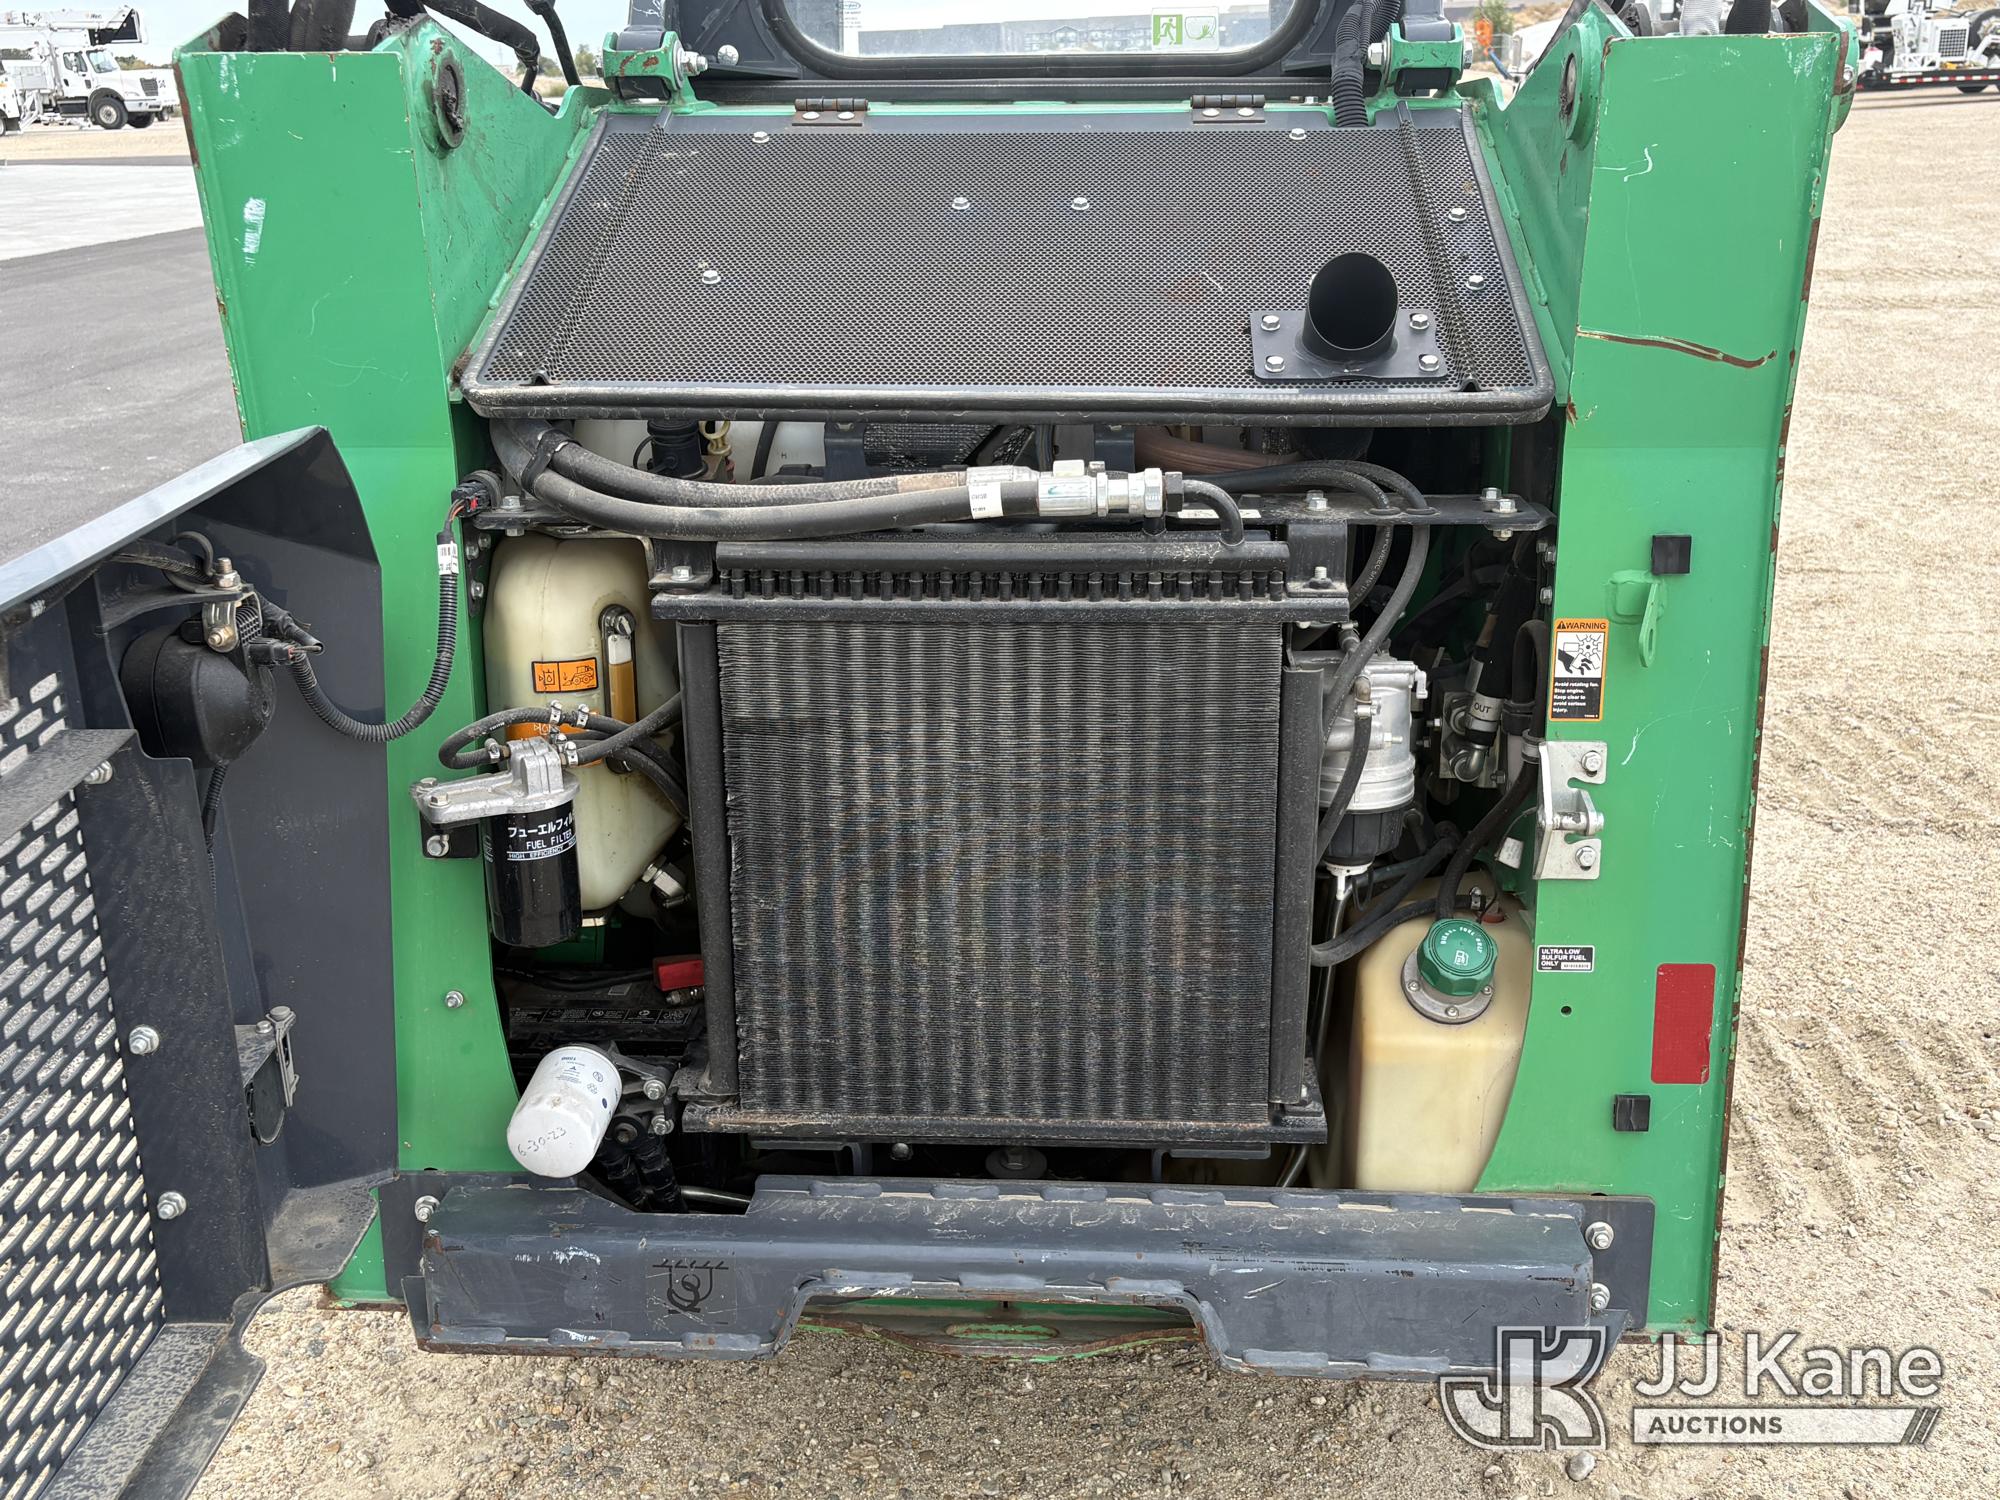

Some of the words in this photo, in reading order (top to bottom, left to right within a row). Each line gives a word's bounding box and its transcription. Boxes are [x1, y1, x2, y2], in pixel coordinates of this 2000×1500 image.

[1566, 622, 1606, 630] WARNING
[1474, 702, 1492, 714] OUT
[526, 839, 547, 850] FUEL
[550, 829, 572, 846] FILTER
[509, 852, 525, 860] HIGH
[530, 844, 564, 859] EFFICIENCY
[517, 1126, 567, 1157] 6-30-23
